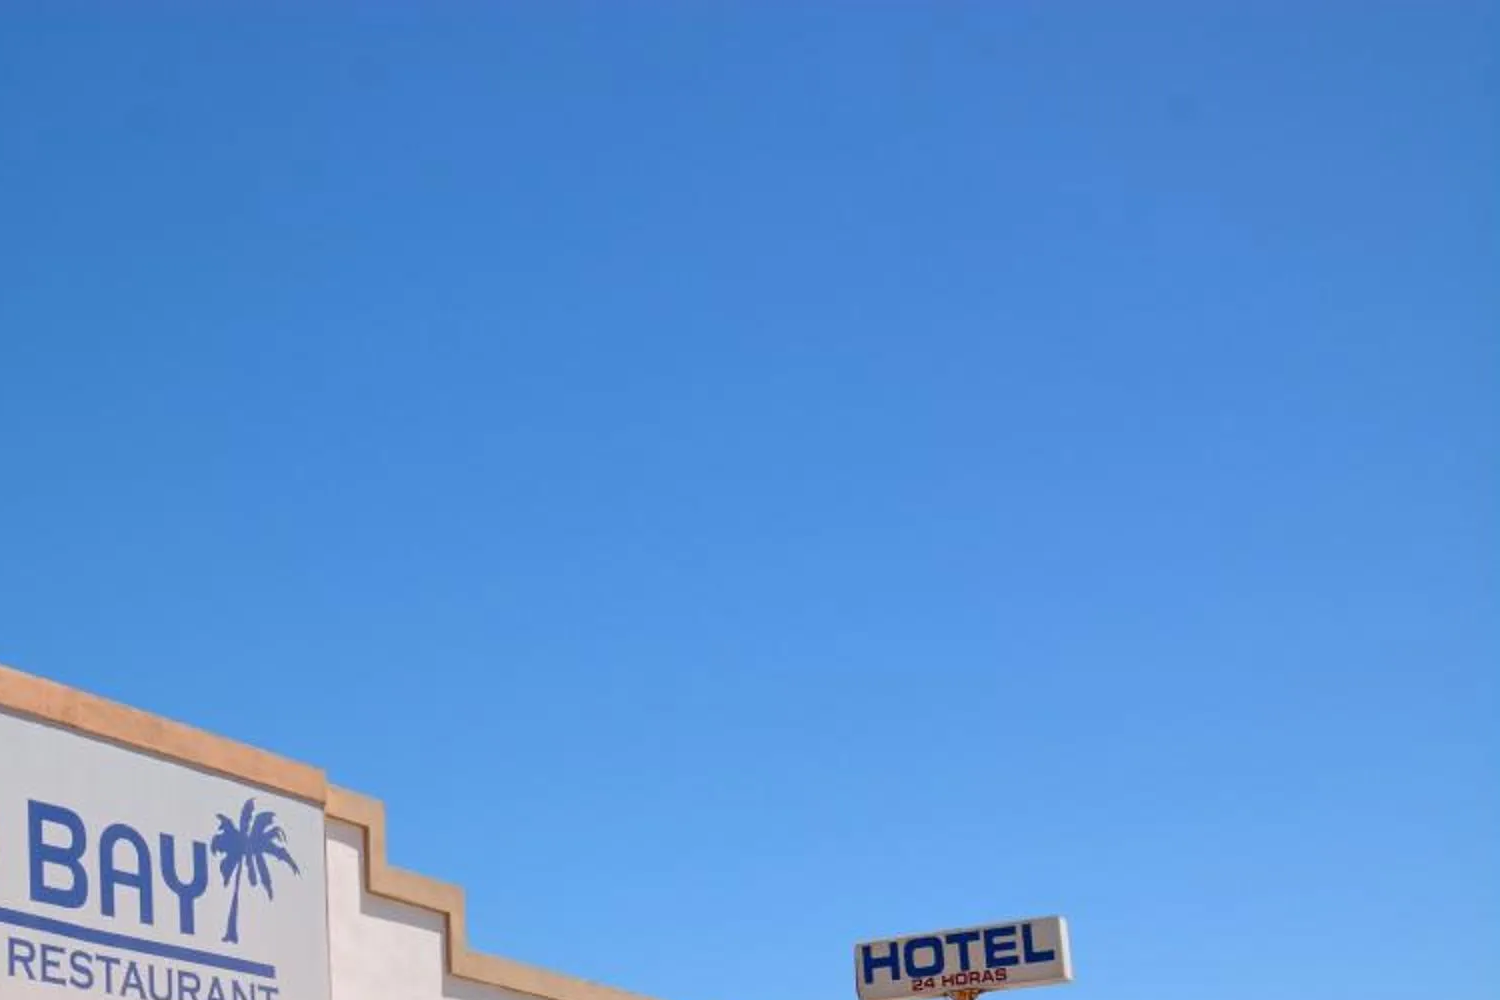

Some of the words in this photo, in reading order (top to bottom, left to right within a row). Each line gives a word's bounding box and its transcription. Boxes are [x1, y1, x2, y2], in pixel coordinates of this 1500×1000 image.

[27, 798, 208, 935] BAY
[862, 923, 1054, 983] HOTEL
[912, 978, 935, 992] 24
[941, 967, 1007, 987] HORAS
